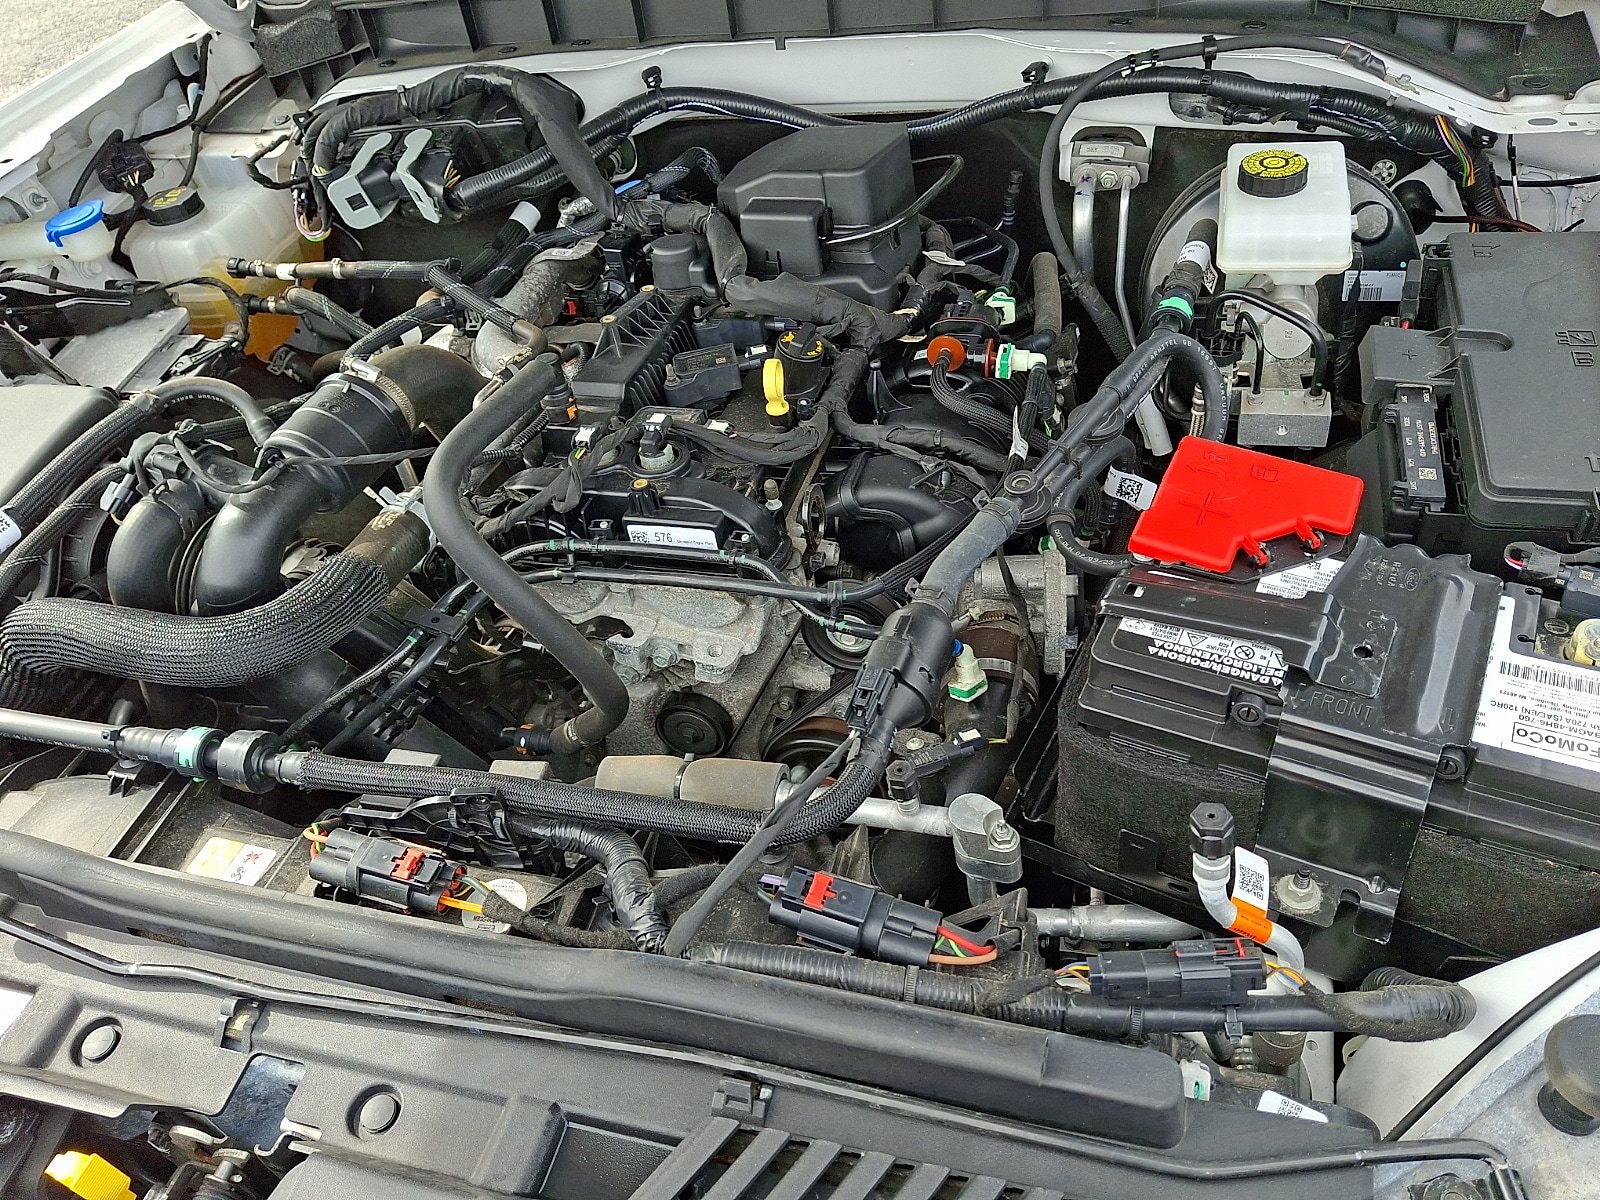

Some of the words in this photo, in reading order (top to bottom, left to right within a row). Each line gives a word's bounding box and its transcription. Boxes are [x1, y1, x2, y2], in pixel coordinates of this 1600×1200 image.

[654, 532, 673, 543] 576
[1157, 648, 1271, 685] DANGER/POISON
[1163, 642, 1285, 678] PELIGRO/VENENO
[1309, 691, 1375, 722] FRONT
[1490, 700, 1518, 712] 120RC
[1516, 728, 1600, 757] FoMoCo
